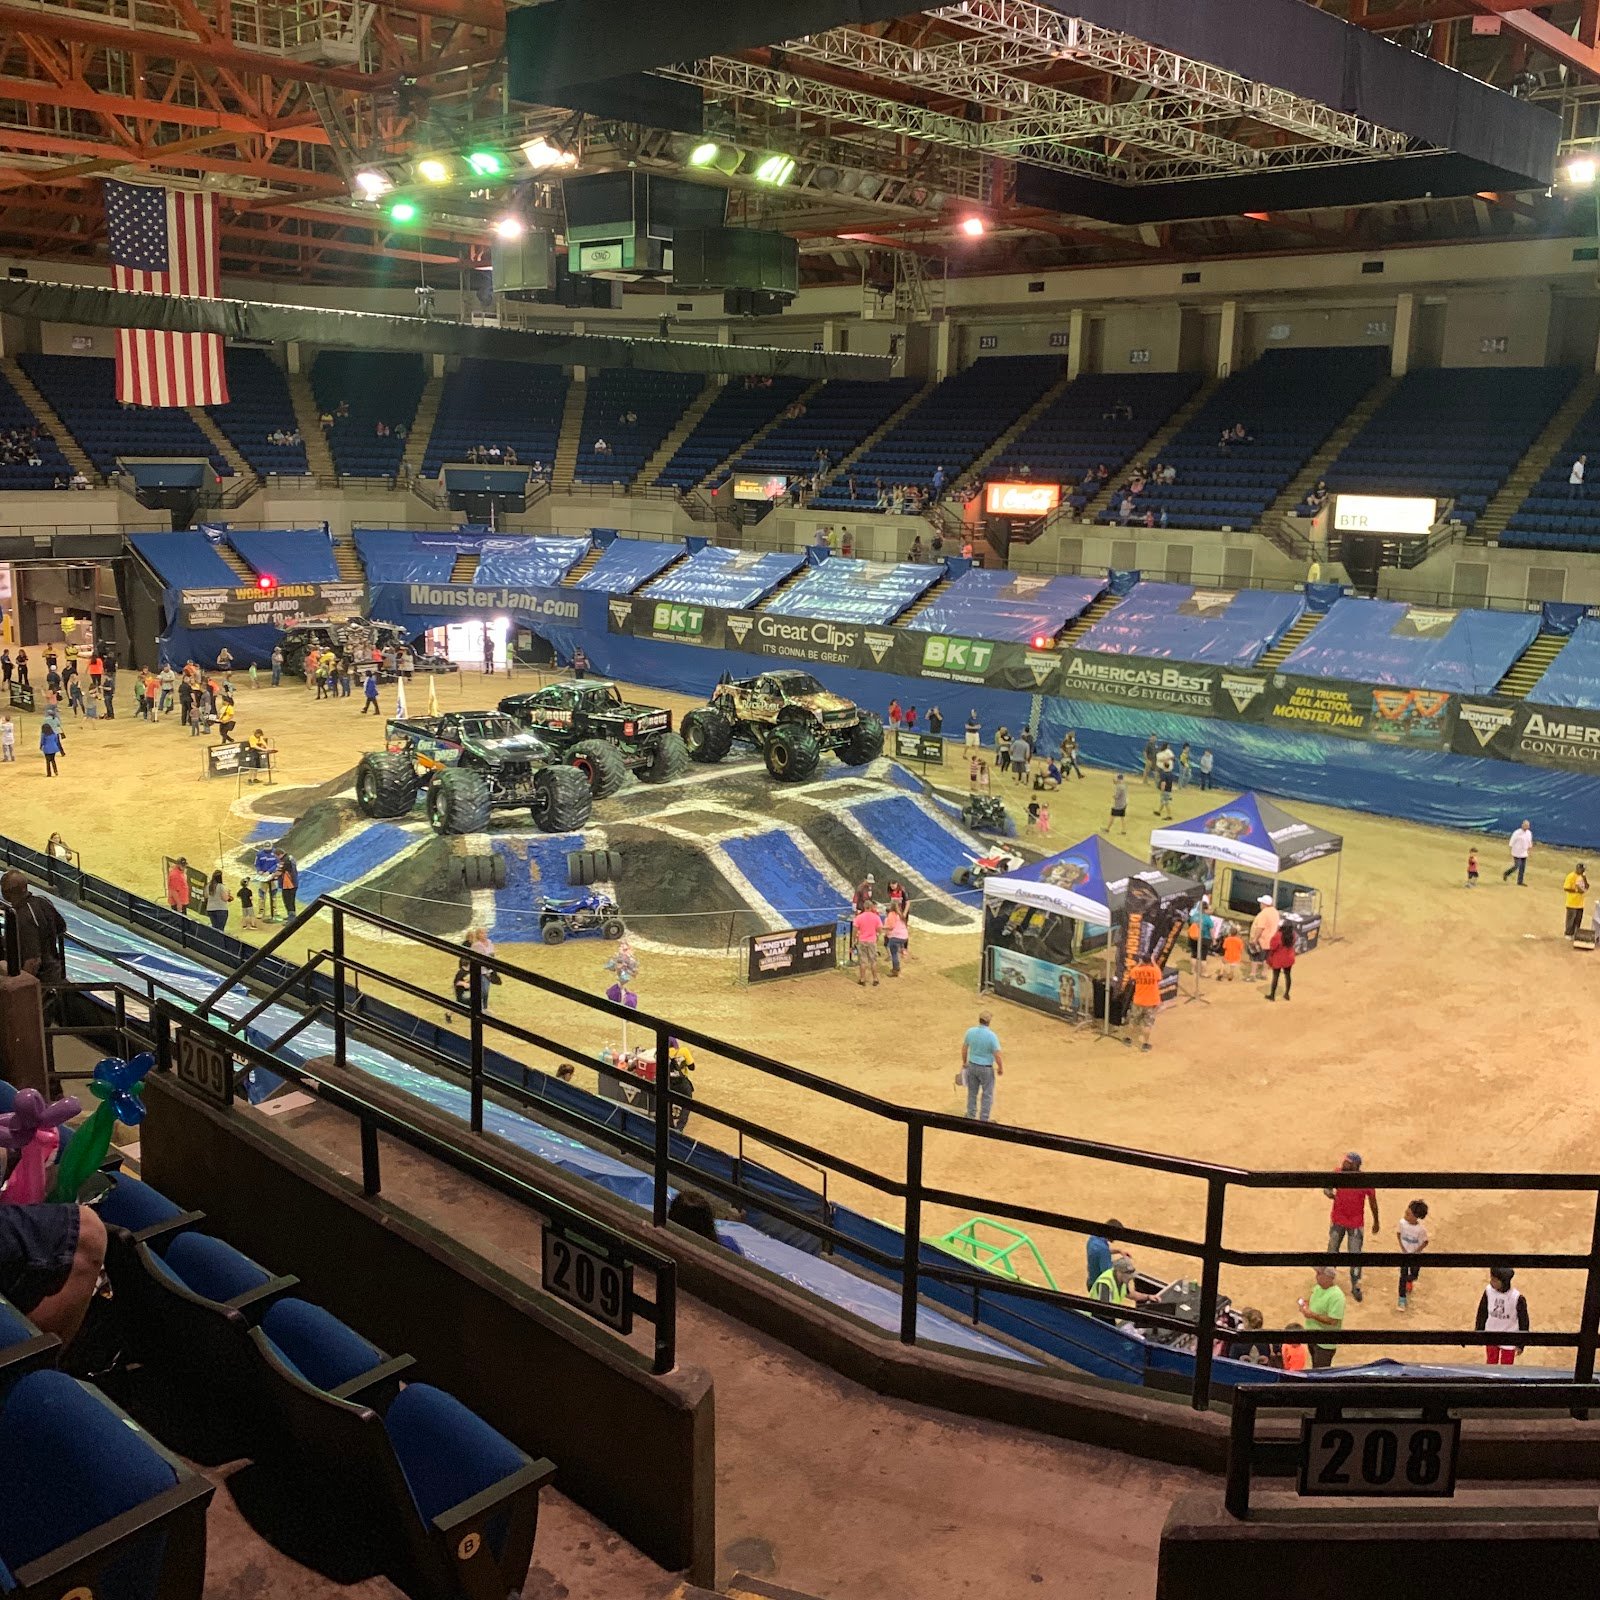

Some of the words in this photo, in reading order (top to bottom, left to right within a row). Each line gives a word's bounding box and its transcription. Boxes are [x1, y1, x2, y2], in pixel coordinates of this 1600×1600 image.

[981, 337, 997, 349] 231
[1051, 334, 1067, 346] 231
[1340, 515, 1368, 527] BTR
[235, 588, 275, 600] WORLD
[277, 585, 315, 598] FINALS
[320, 589, 364, 598] MONSTER
[183, 595, 228, 605] MONSTER
[195, 603, 220, 611] JAM
[253, 600, 299, 612] ORLANDO
[330, 597, 357, 605] JAM
[410, 585, 579, 618] MonsterJam.com
[247, 613, 269, 625] MAY
[272, 612, 284, 624] 10
[654, 607, 703, 629] BKT
[757, 616, 808, 642] Great
[763, 644, 776, 654] IT'S
[778, 645, 806, 659] GONNA
[808, 650, 819, 660] BE
[821, 653, 850, 664] GREAT
[926, 641, 991, 667] BKT
[921, 669, 951, 679] GROWING
[951, 673, 985, 685] TOGETHER
[1065, 678, 1126, 695] CONTACTS
[1127, 685, 1141, 697] &
[1141, 688, 1212, 707] EYEGLASSES
[1221, 681, 1264, 694] MONSTER
[1295, 687, 1315, 697] REAL
[1289, 695, 1312, 707] REAL
[1272, 705, 1330, 724] MONSTER
[1331, 713, 1364, 728] JAM!
[1459, 711, 1512, 726] MONSTER
[1473, 720, 1498, 731] JAM
[754, 937, 797, 952] MONSTER
[767, 946, 786, 956] JAM
[803, 951, 814, 959] MAY
[183, 1040, 224, 1093] 209
[553, 1241, 620, 1318] 209
[1317, 1429, 1443, 1485] 208
[464, 1539, 474, 1554] B
